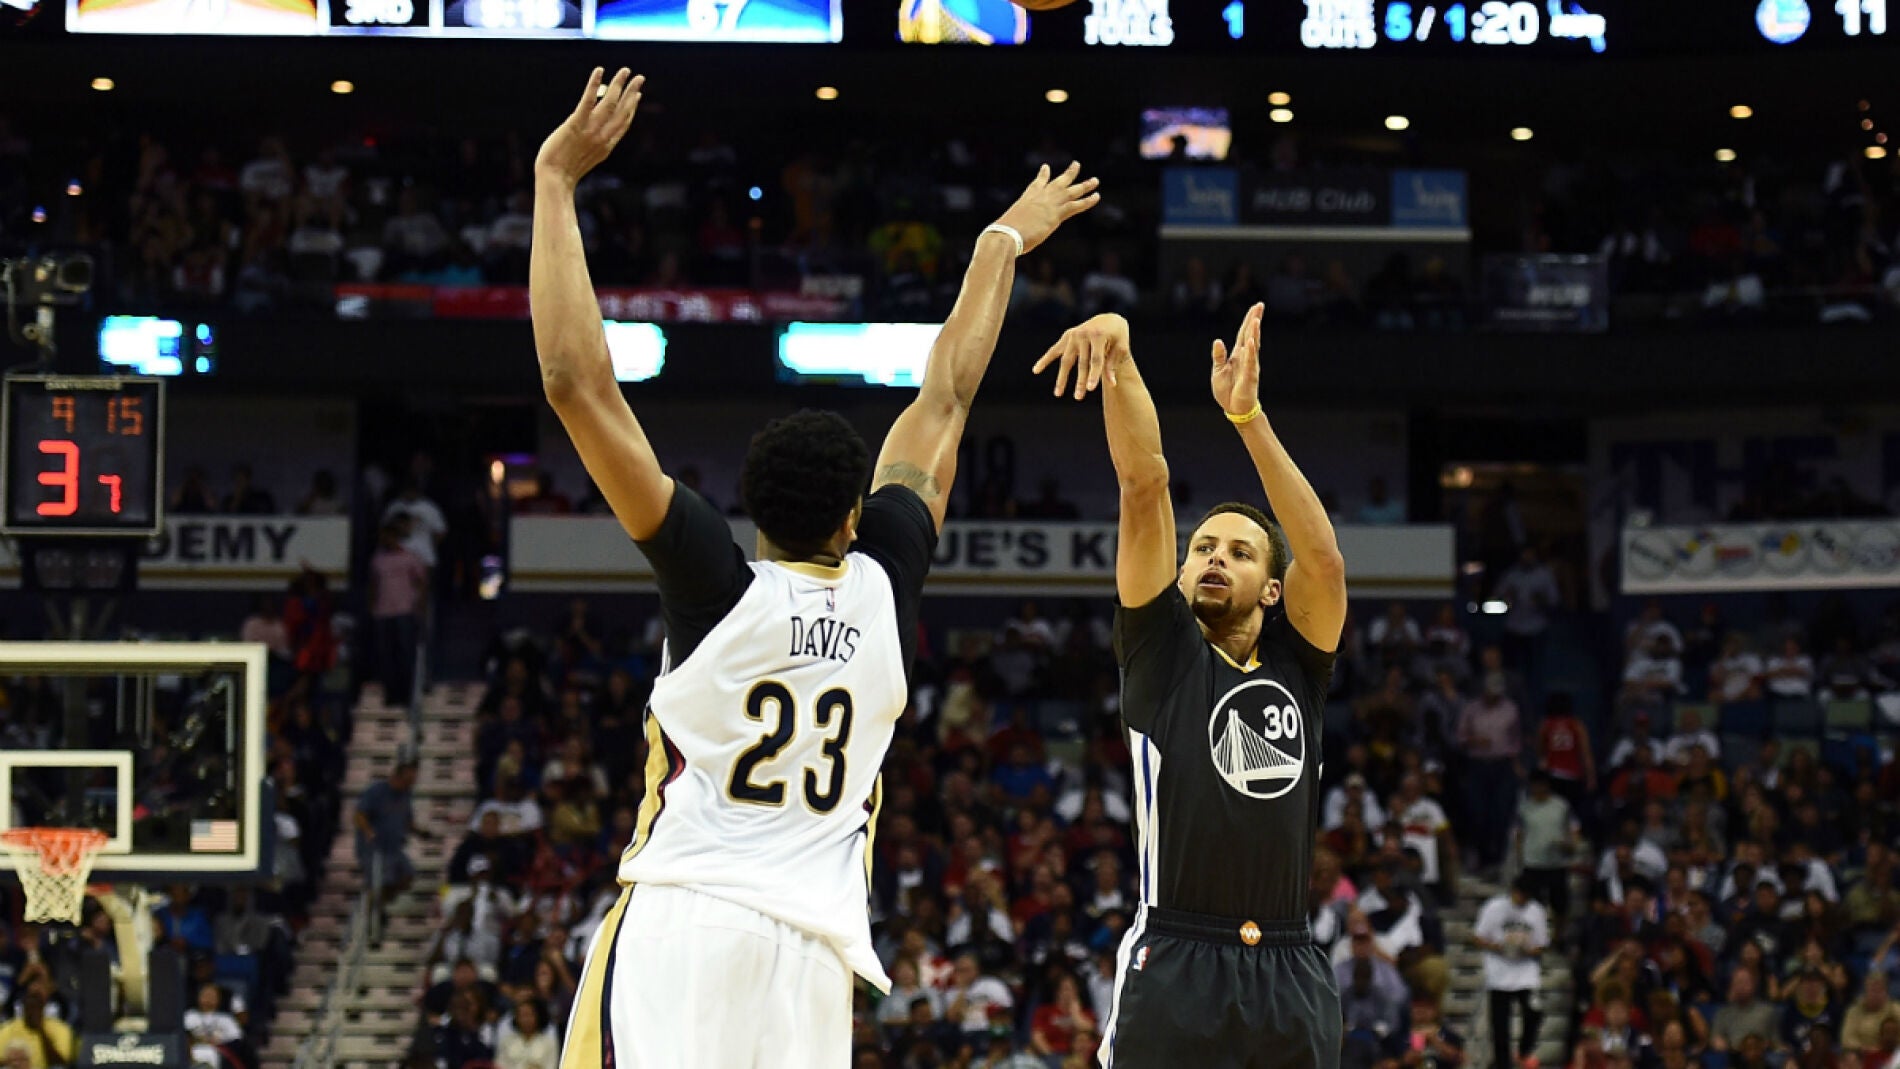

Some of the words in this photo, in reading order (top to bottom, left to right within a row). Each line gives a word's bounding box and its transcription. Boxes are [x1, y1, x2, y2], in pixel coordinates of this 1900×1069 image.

[1223, 0, 1244, 39] 1
[107, 397, 143, 435] 15
[36, 439, 80, 516] 3
[98, 474, 121, 513] 7
[790, 616, 861, 663] DAVIS
[1262, 704, 1299, 740] 30
[727, 678, 855, 816] 23
[92, 1043, 164, 1065] SPALDING
